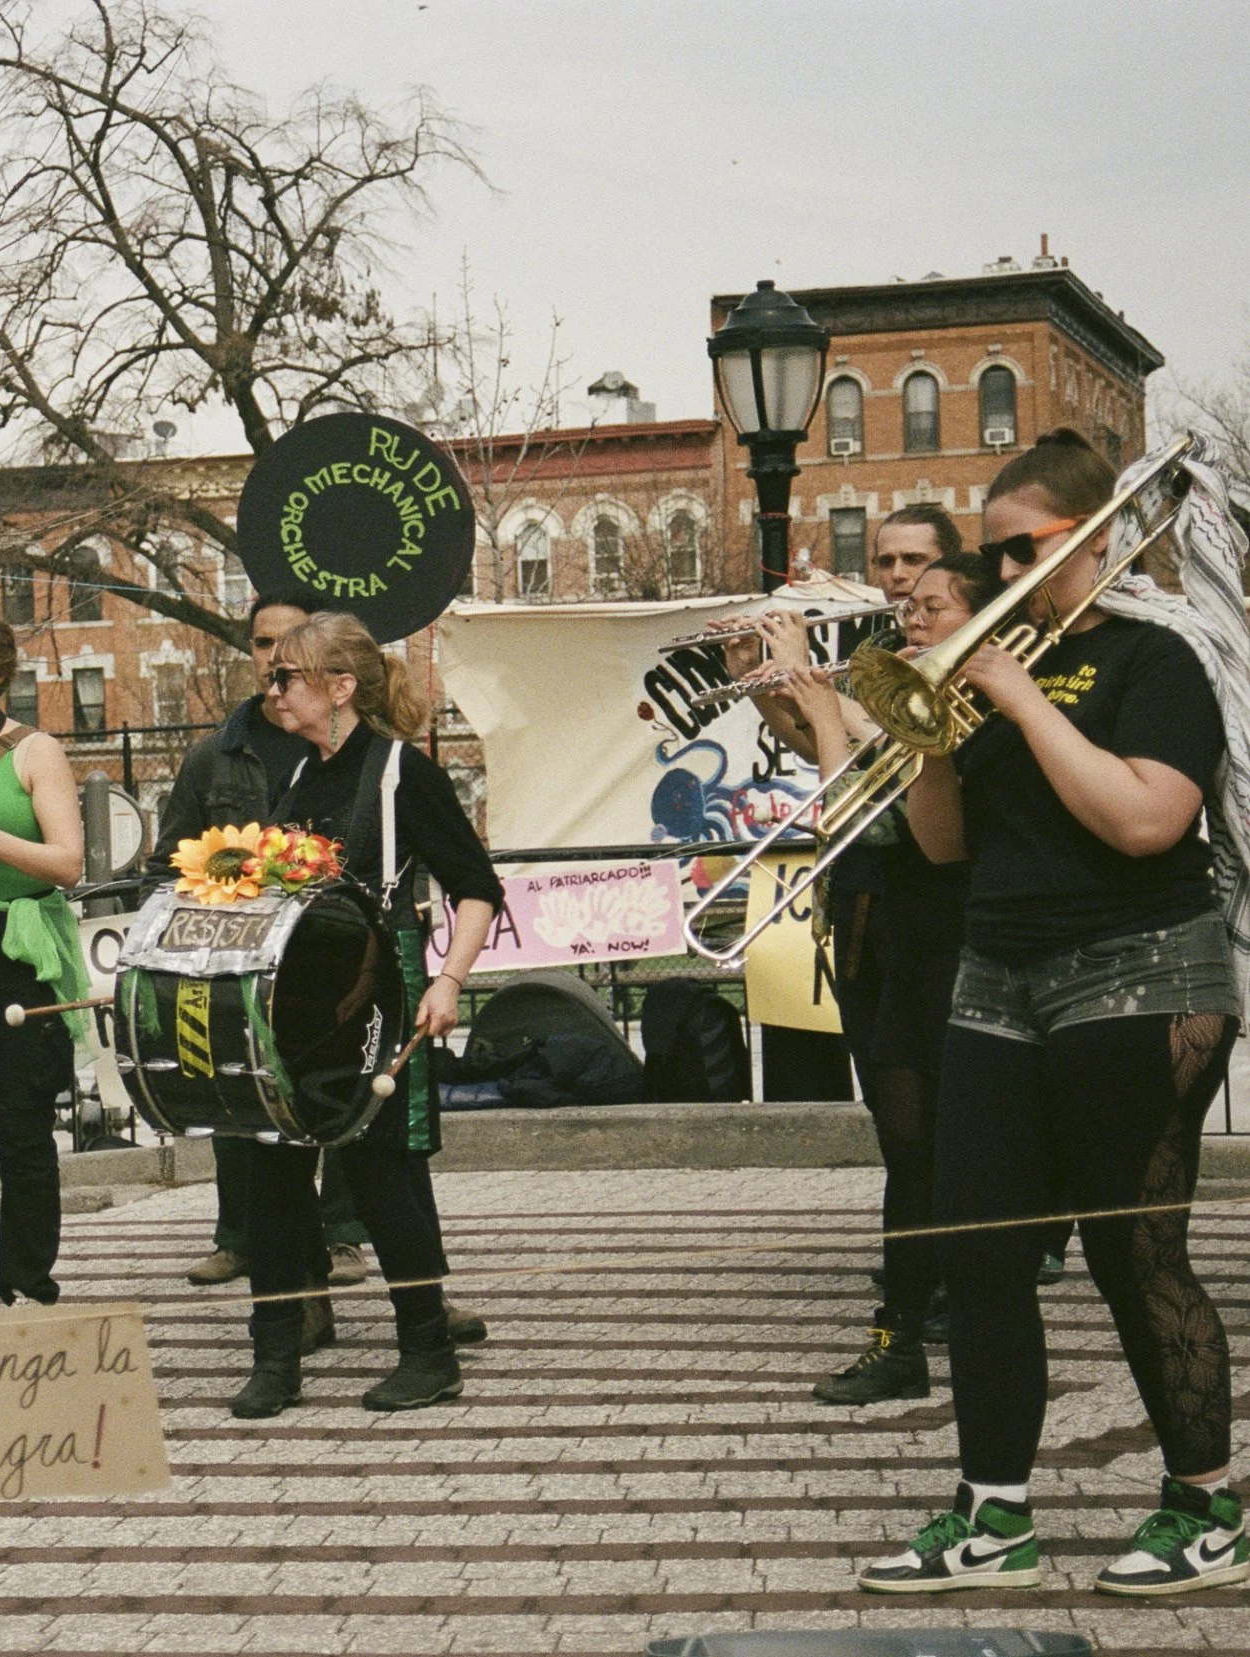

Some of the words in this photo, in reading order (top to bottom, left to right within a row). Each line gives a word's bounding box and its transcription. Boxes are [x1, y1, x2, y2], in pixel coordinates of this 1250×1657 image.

[369, 427, 460, 517] RUDE
[280, 491, 388, 597] ORCHESTRA
[304, 462, 426, 571] MECHANICAL
[527, 881, 543, 892] AL
[161, 910, 268, 949] RESIST!
[607, 938, 650, 952] NOW!
[94, 1318, 138, 1374] la
